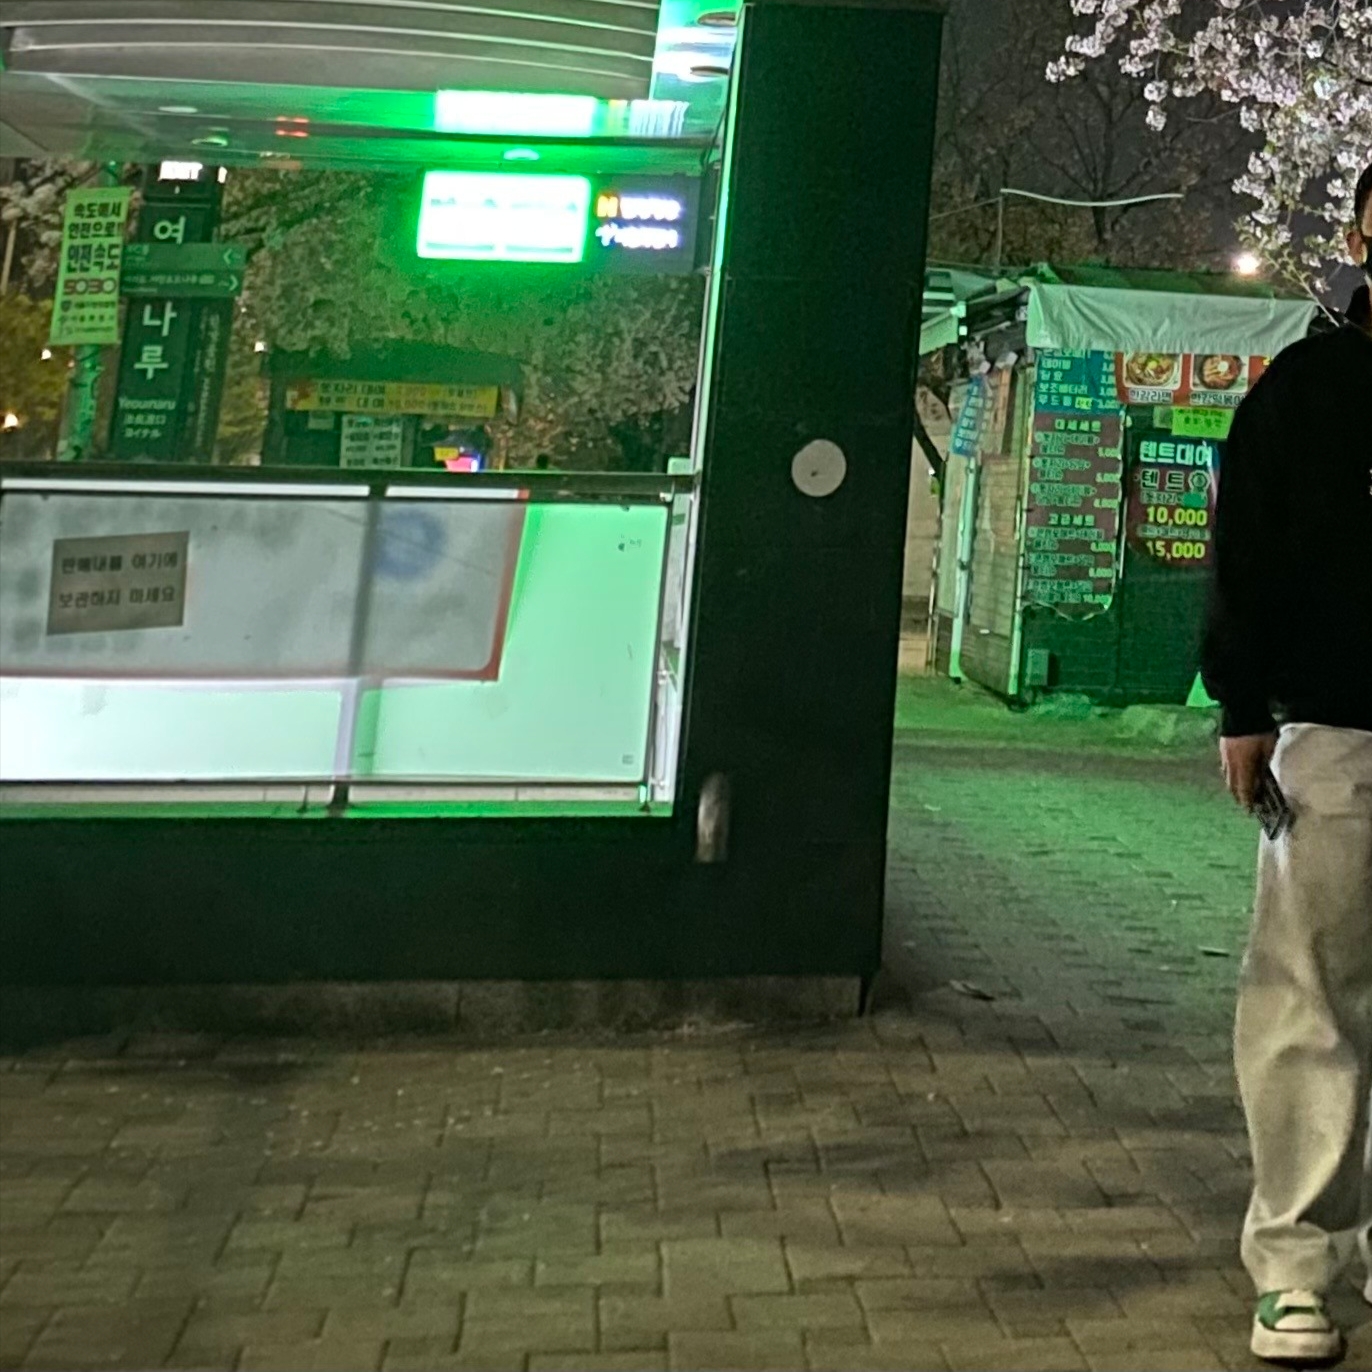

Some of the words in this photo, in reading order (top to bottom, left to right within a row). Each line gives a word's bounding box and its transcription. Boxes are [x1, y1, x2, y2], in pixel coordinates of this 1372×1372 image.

[67, 241, 120, 273] 안전속도
[63, 278, 117, 295] 5030
[1140, 441, 1213, 466] 텐트대여
[1147, 506, 1208, 527] 10,000
[1146, 540, 1206, 561] 15,000
[129, 585, 176, 603] 마세요
